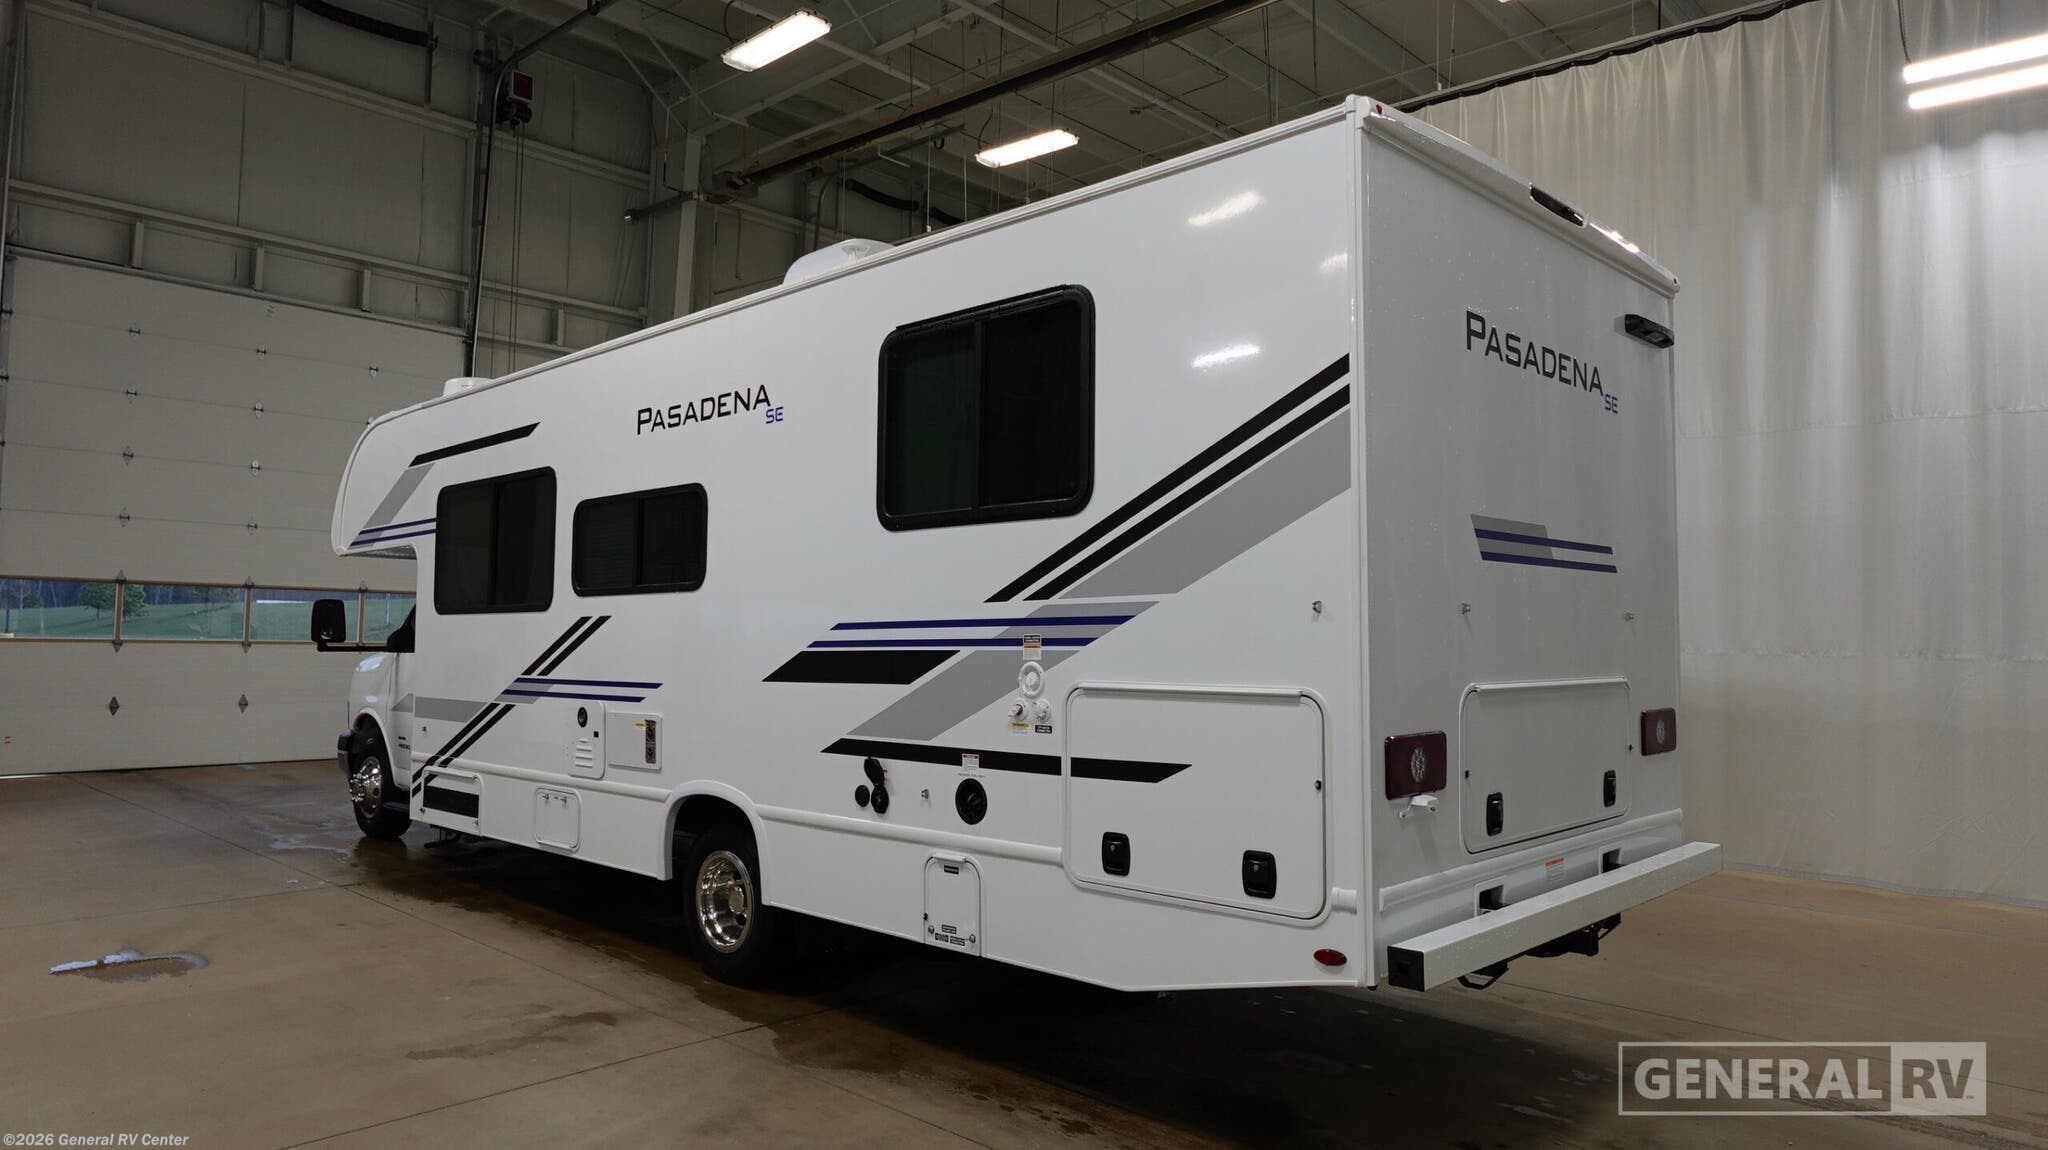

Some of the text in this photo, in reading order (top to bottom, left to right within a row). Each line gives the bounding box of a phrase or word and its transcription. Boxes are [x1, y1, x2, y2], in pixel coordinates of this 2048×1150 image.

[1466, 310, 1618, 413] PASADENA SE
[637, 384, 784, 435] PASADENA SE
